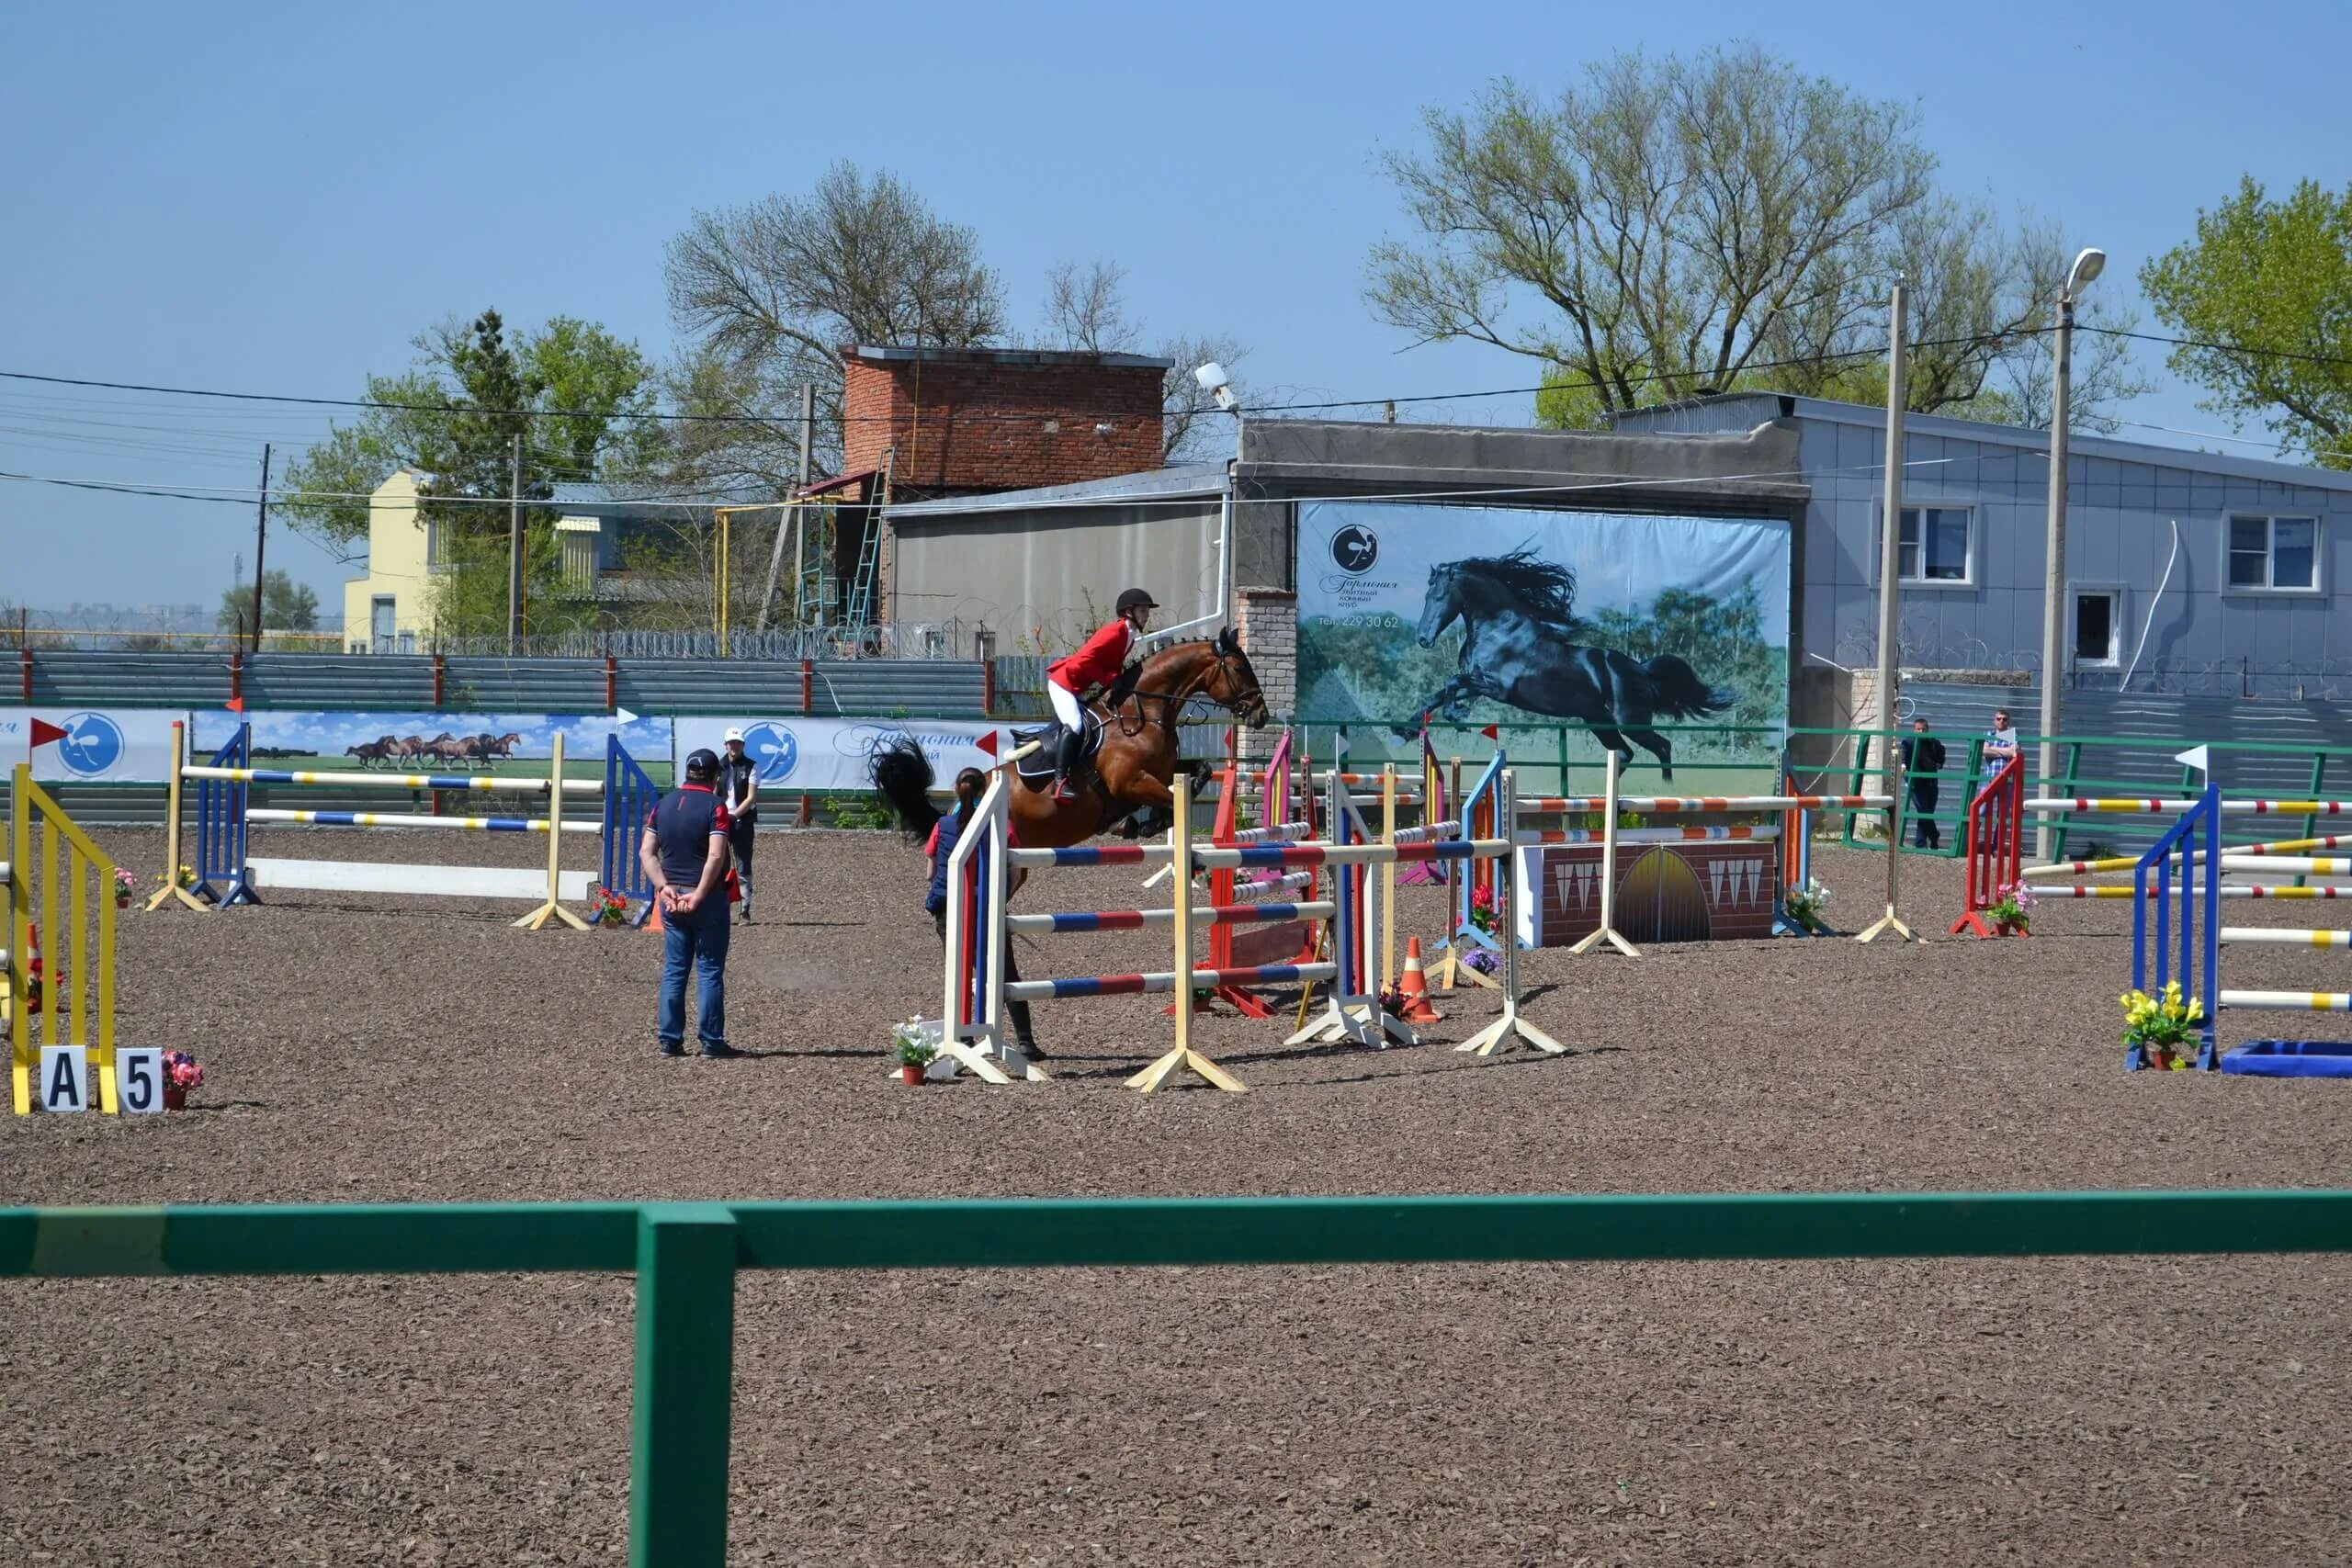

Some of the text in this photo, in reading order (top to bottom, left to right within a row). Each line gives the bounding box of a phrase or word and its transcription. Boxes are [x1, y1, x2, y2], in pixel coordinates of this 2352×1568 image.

[1318, 575, 1397, 594] Гармония
[1317, 615, 1399, 628] тел. 229 30 62
[128, 1055, 152, 1110] 5
